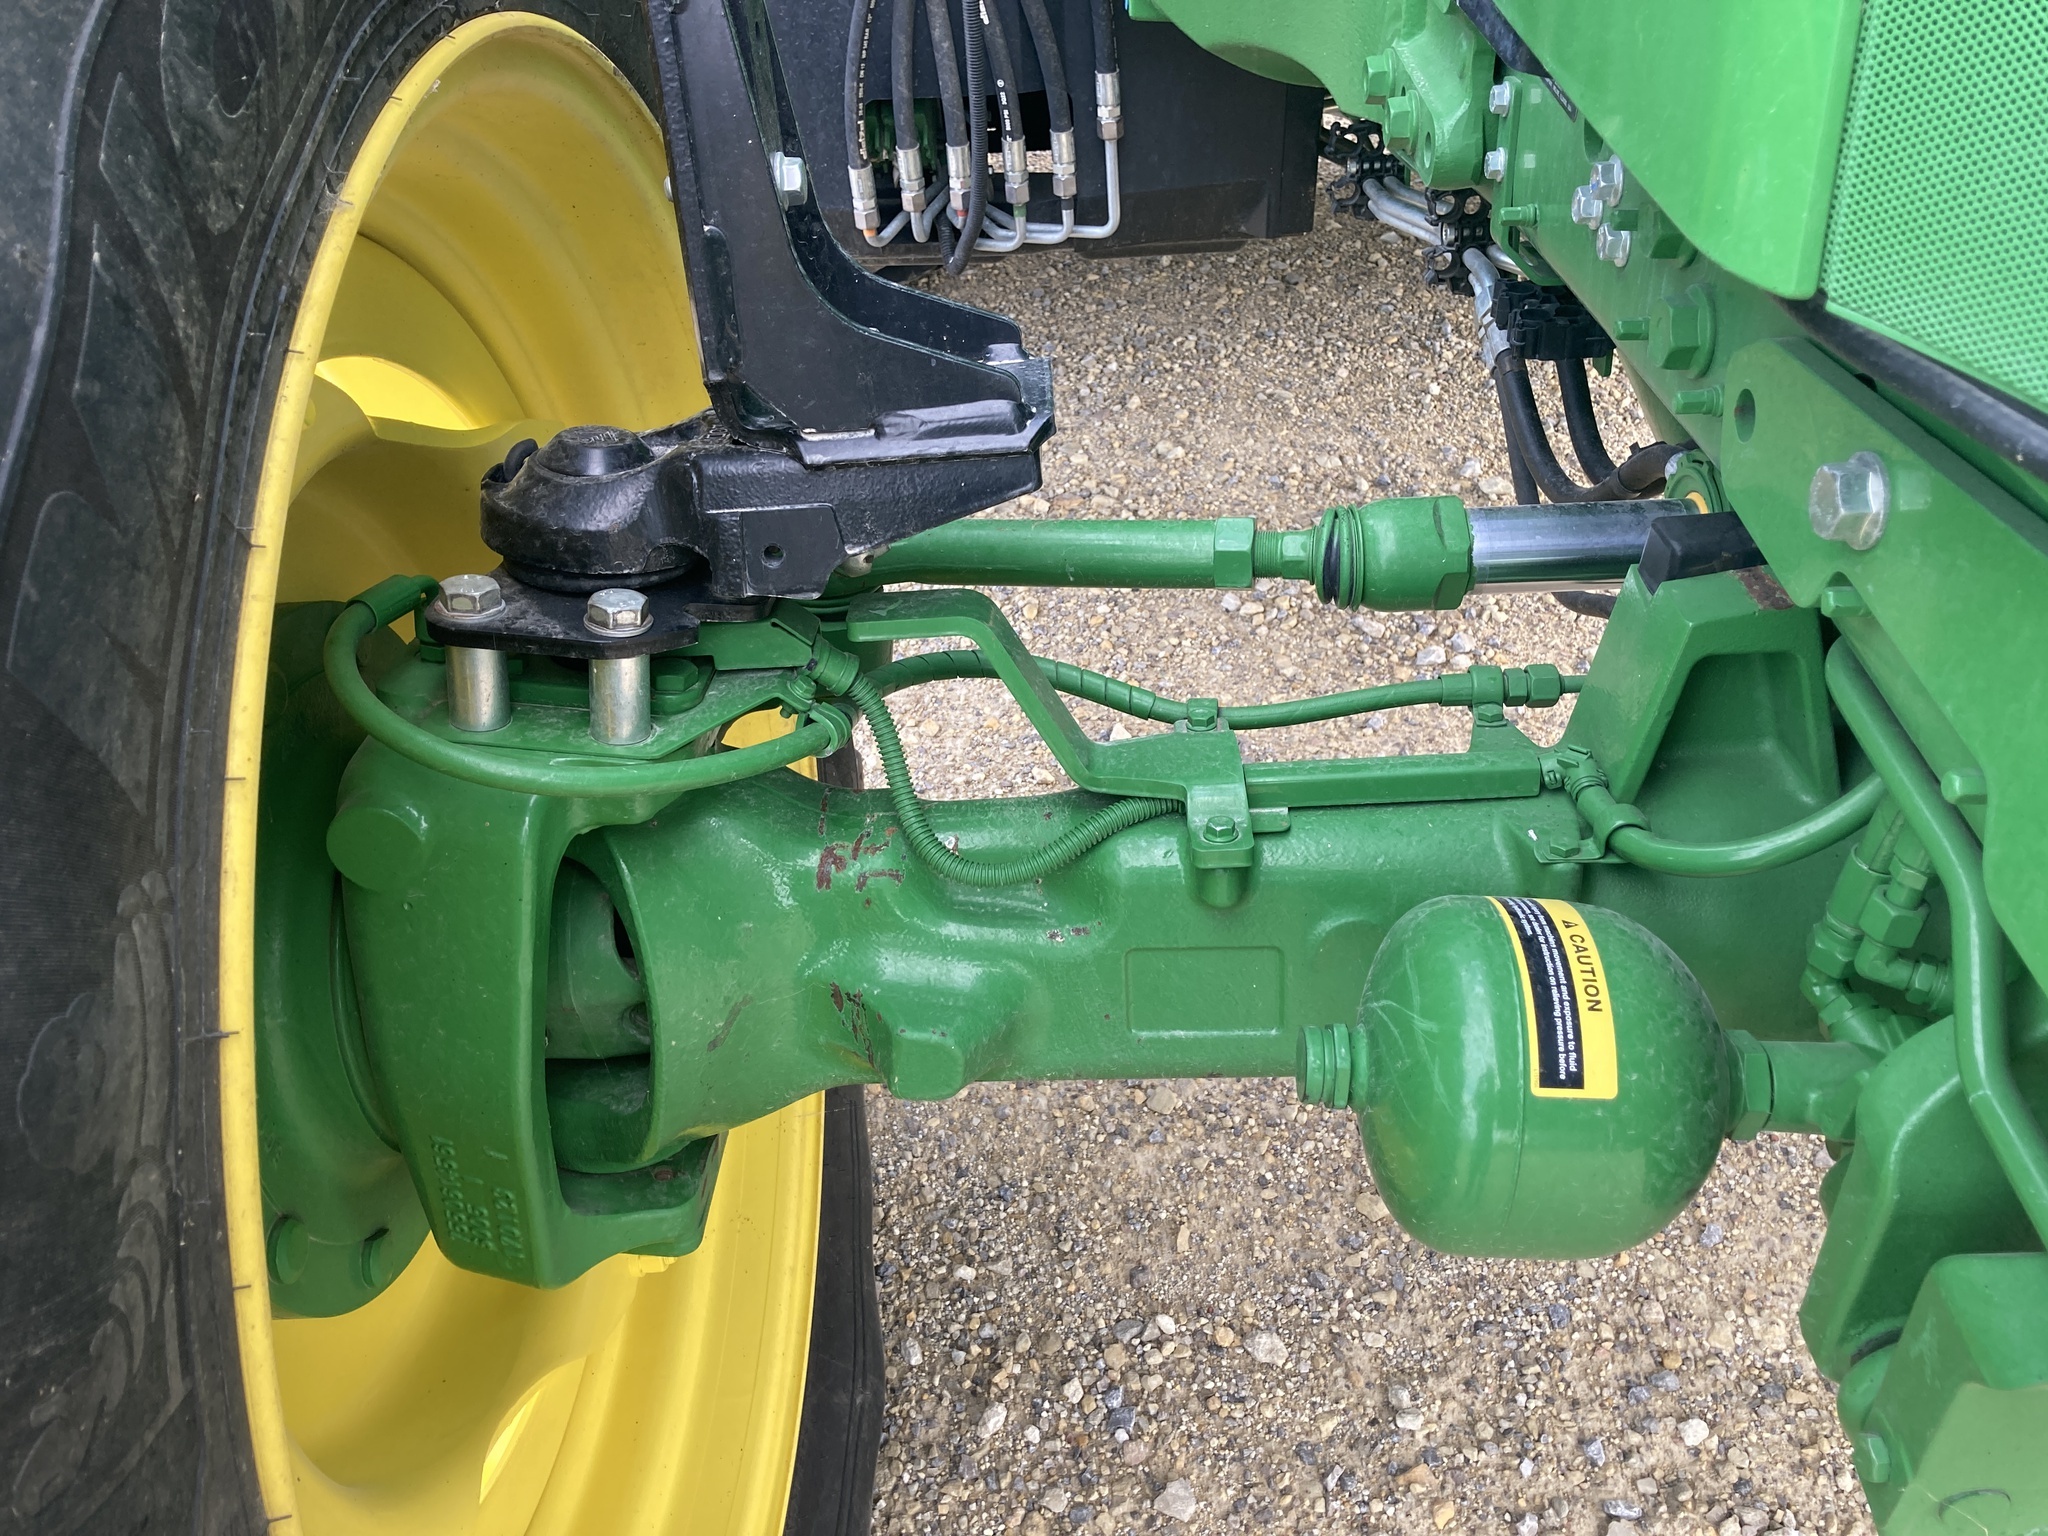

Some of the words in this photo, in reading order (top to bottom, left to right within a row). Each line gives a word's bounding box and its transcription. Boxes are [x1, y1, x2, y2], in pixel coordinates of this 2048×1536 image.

[1537, 935, 1546, 944] for
[1542, 925, 1557, 948] machine
[1540, 943, 1555, 976] instruction
[1551, 948, 1567, 984] movement
[1549, 976, 1557, 986] on
[1570, 934, 1603, 1013] CAUTION
[1550, 986, 1562, 1017] relieving
[1560, 985, 1571, 1000] and
[1563, 1001, 1574, 1040] exposure
[1554, 1017, 1565, 1052] pressure
[1567, 1041, 1576, 1051] to
[1558, 1053, 1568, 1080] before
[1568, 1052, 1578, 1072] fluid
